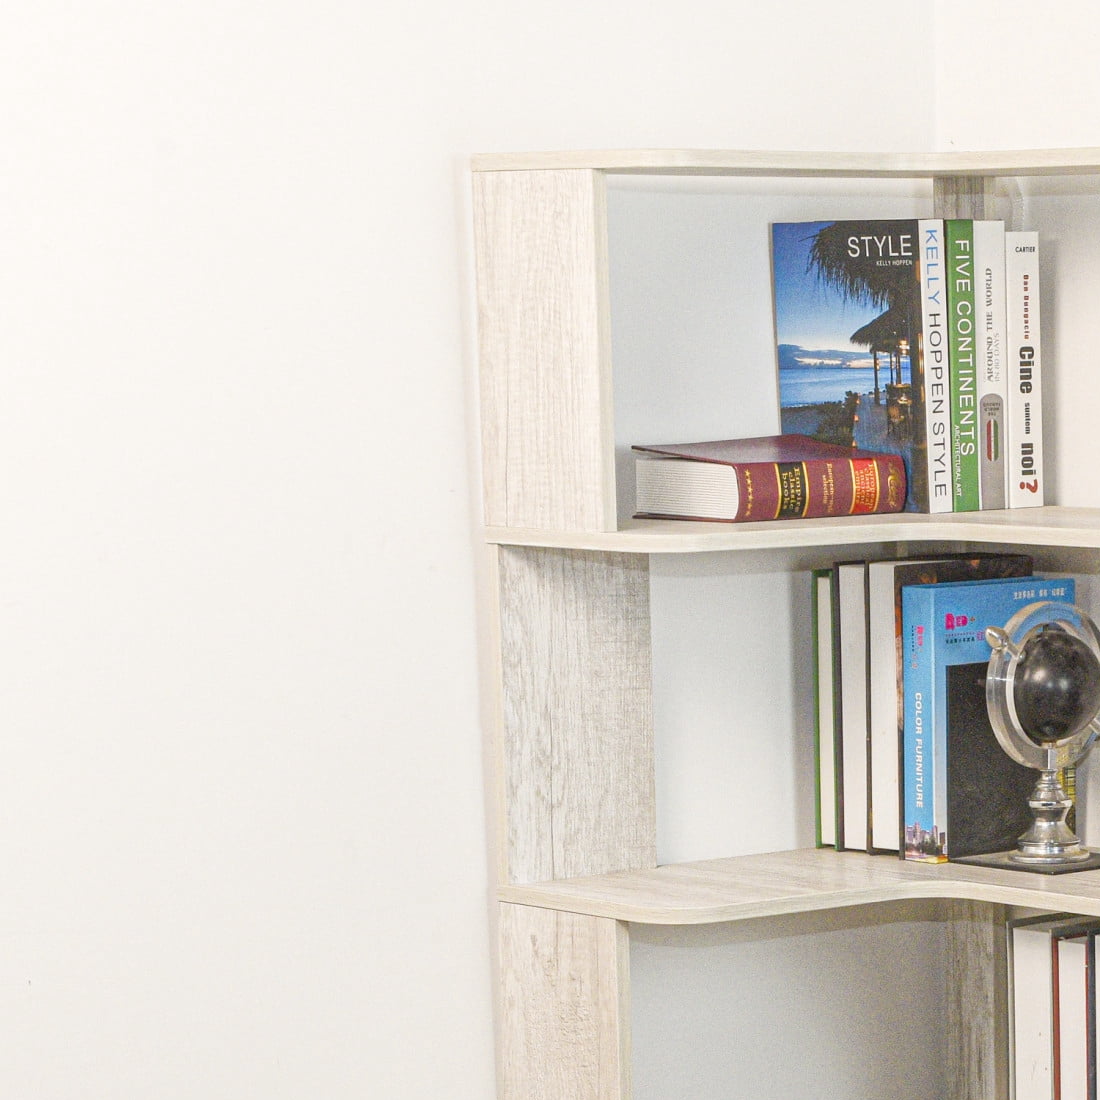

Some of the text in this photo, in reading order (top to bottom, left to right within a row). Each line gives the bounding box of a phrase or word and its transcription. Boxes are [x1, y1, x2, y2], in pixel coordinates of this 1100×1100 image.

[847, 235, 913, 257] STYLE
[985, 310, 993, 332] THE
[925, 229, 947, 498] KELLY HOPPEN STYLE
[955, 239, 975, 456] FIVE CONTINENTS
[986, 336, 994, 382] AROUND
[1019, 346, 1035, 394] Cine
[915, 692, 924, 808] COLOR FURNITURE
